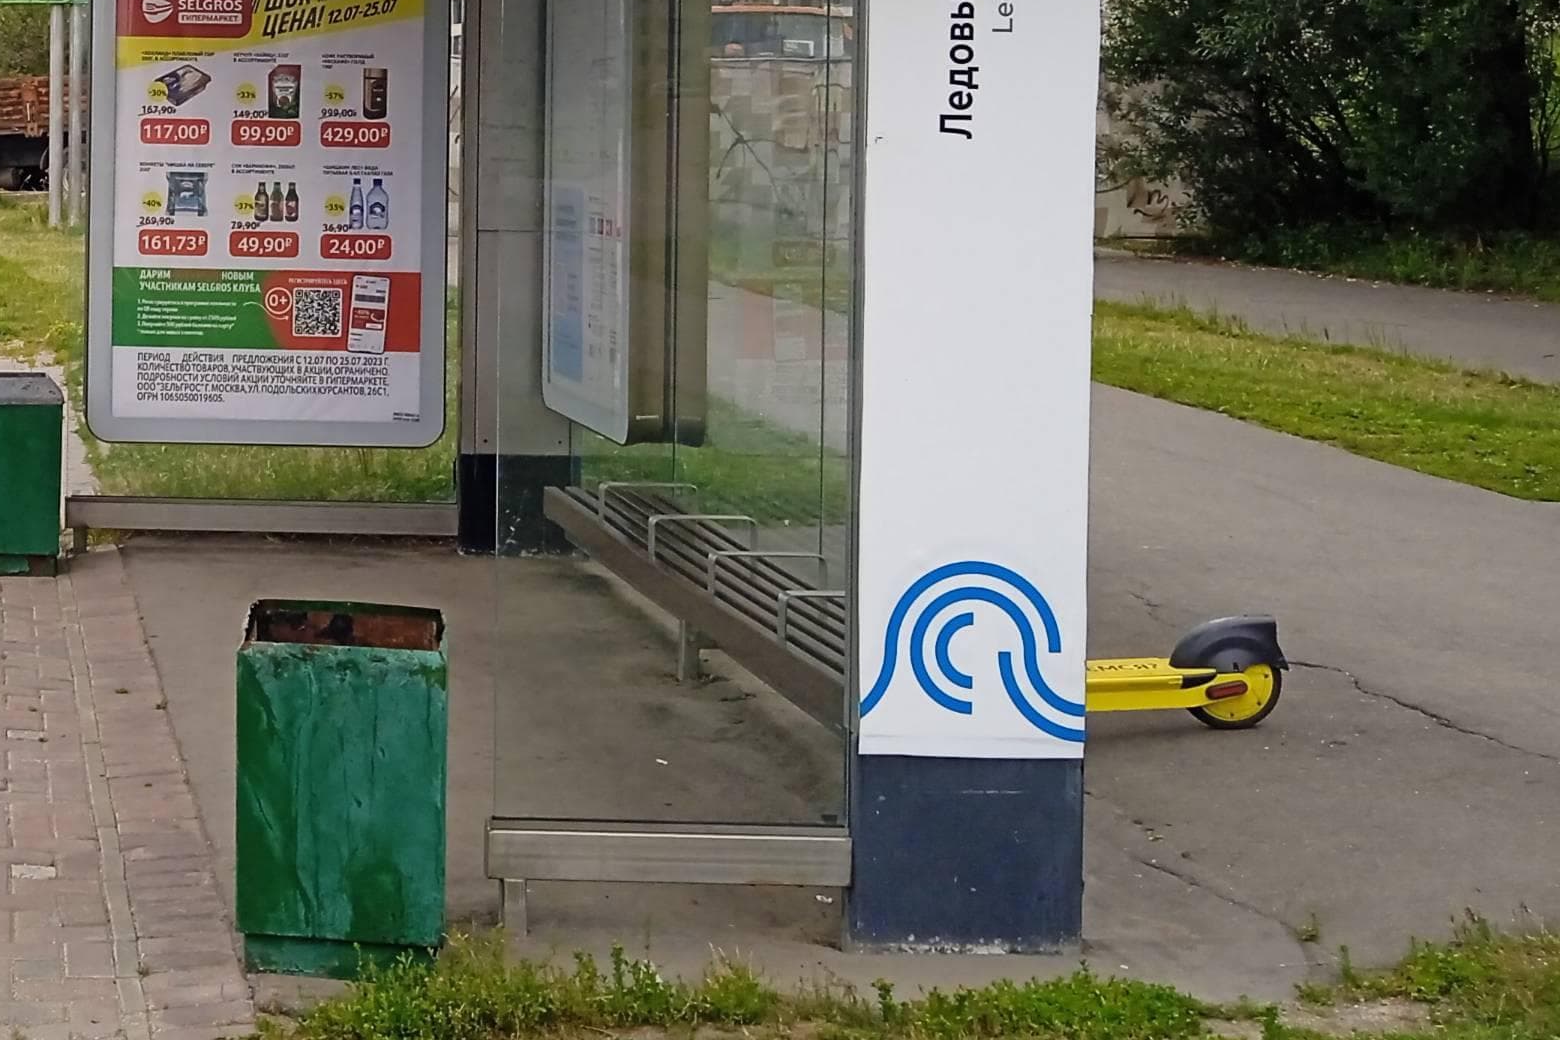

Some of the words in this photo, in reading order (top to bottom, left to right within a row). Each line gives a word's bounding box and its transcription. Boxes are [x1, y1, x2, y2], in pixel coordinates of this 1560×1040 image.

[180, 14, 240, 23] ГИПЕРМАРКЕТ
[262, 6, 325, 38] ЦЕНА!
[140, 270, 171, 280] ДАРИМ
[222, 272, 254, 281] НОВЫМ
[140, 281, 196, 292] УЧАСТНИКАМ
[197, 283, 231, 292] SELGROS
[233, 283, 261, 293] КЛУБА
[269, 295, 288, 306] 0+
[137, 352, 170, 362] ПЕРИОД
[182, 352, 224, 363] ДЕЙСТВИЯ
[232, 354, 294, 364] ПРЕДЛОЖЕНИЯ
[296, 355, 301, 364] С
[304, 356, 324, 365] 12.07
[326, 356, 338, 365] ПО
[137, 363, 190, 372] КОЛИЧЕСТВО
[231, 365, 295, 375] УЧАСТВУЮЩИХ
[297, 366, 302, 374] В
[137, 372, 198, 382] ПОДРОБНОСТИ
[200, 373, 238, 383] УСЛОВИЙ
[241, 374, 269, 384] АКЦИИ
[271, 375, 316, 385] УТОЧНЯЙТЕ
[319, 376, 324, 384] В
[137, 382, 156, 391] ООО
[261, 385, 317, 395] ПОДОЛЬСКИХ
[137, 392, 158, 401] ОГРН
